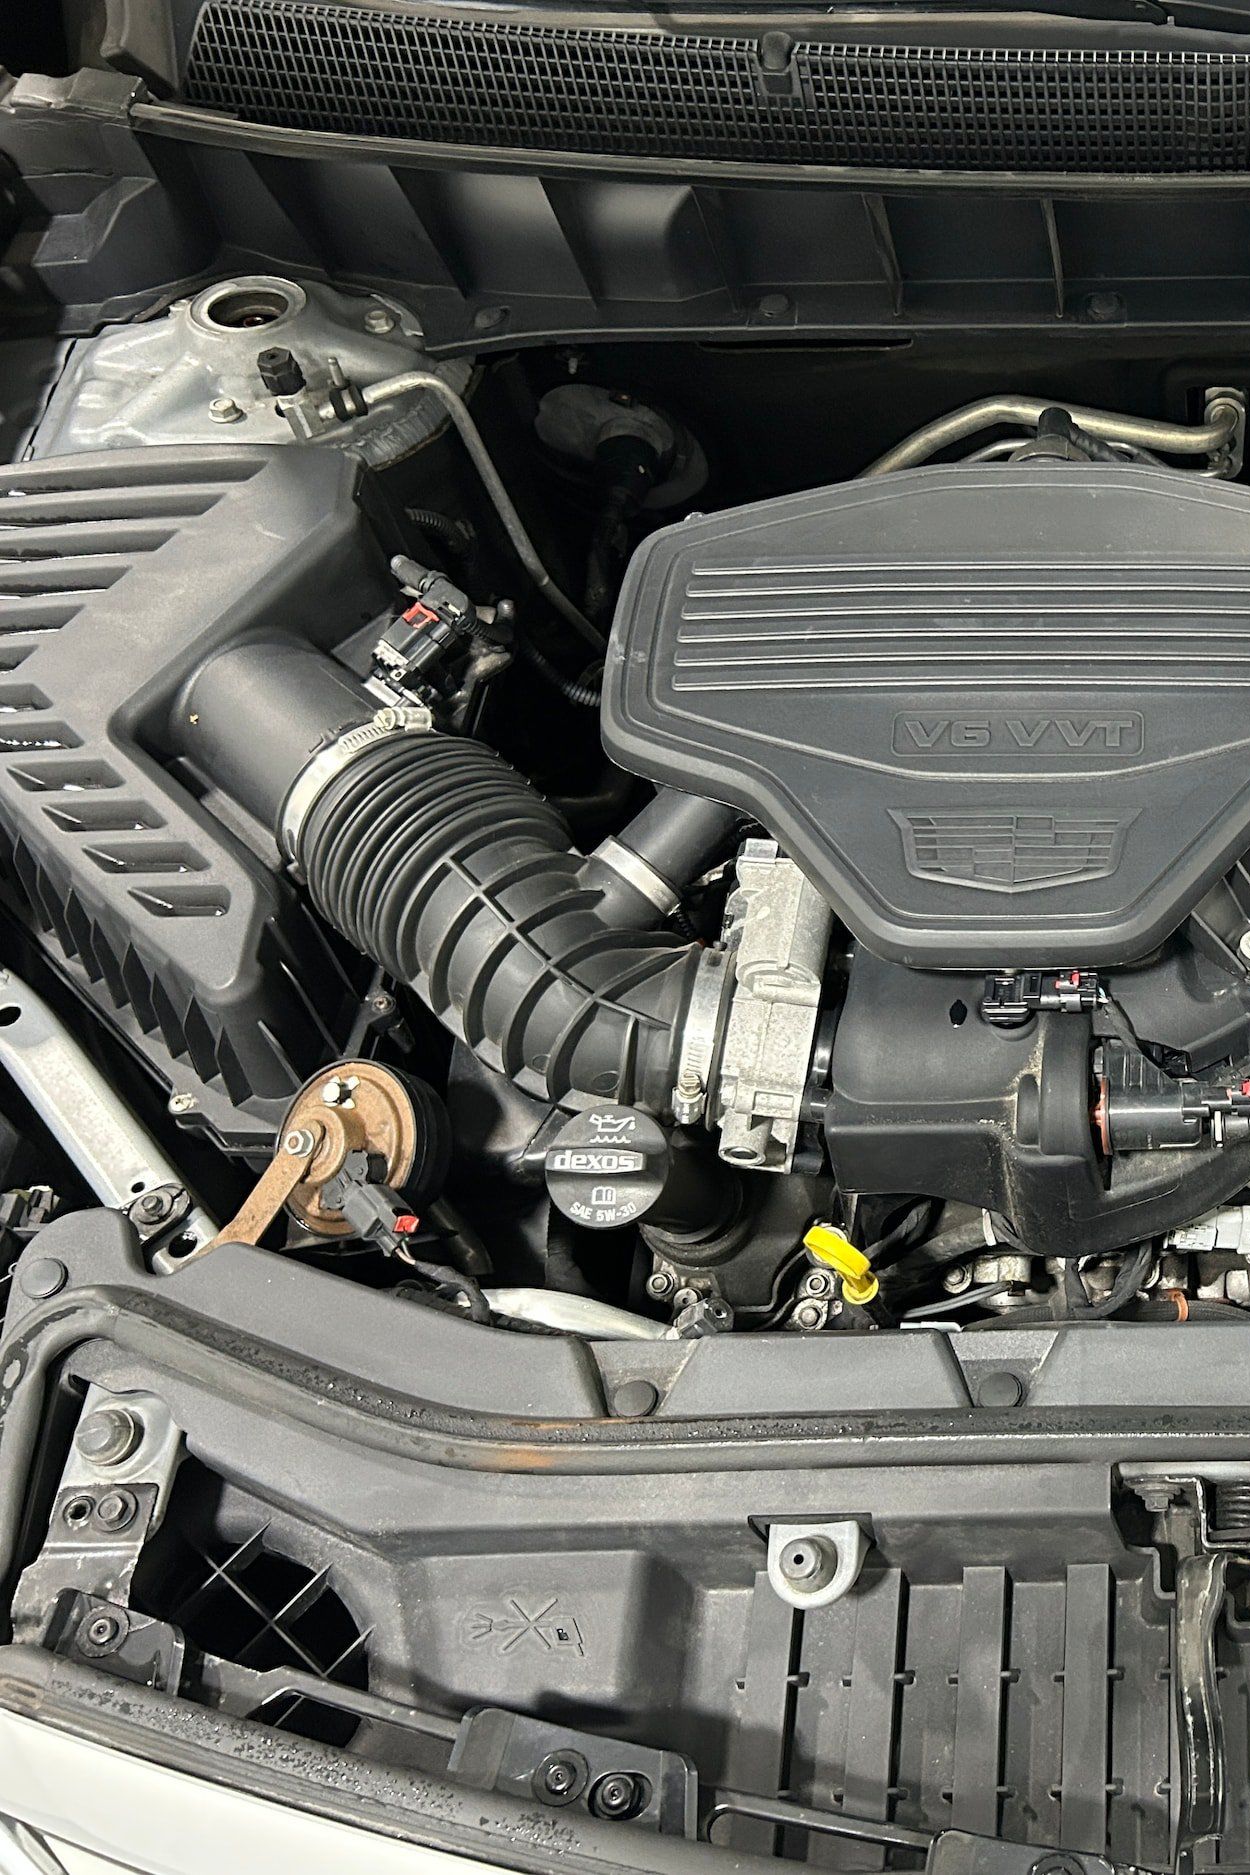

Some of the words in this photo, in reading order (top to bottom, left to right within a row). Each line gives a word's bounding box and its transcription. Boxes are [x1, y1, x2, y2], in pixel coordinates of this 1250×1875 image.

[904, 720, 992, 747] V6
[1005, 720, 1133, 747] VVT
[554, 1150, 635, 1169] dexos
[569, 1201, 593, 1220] SAE
[596, 1201, 637, 1220] 5W-30
